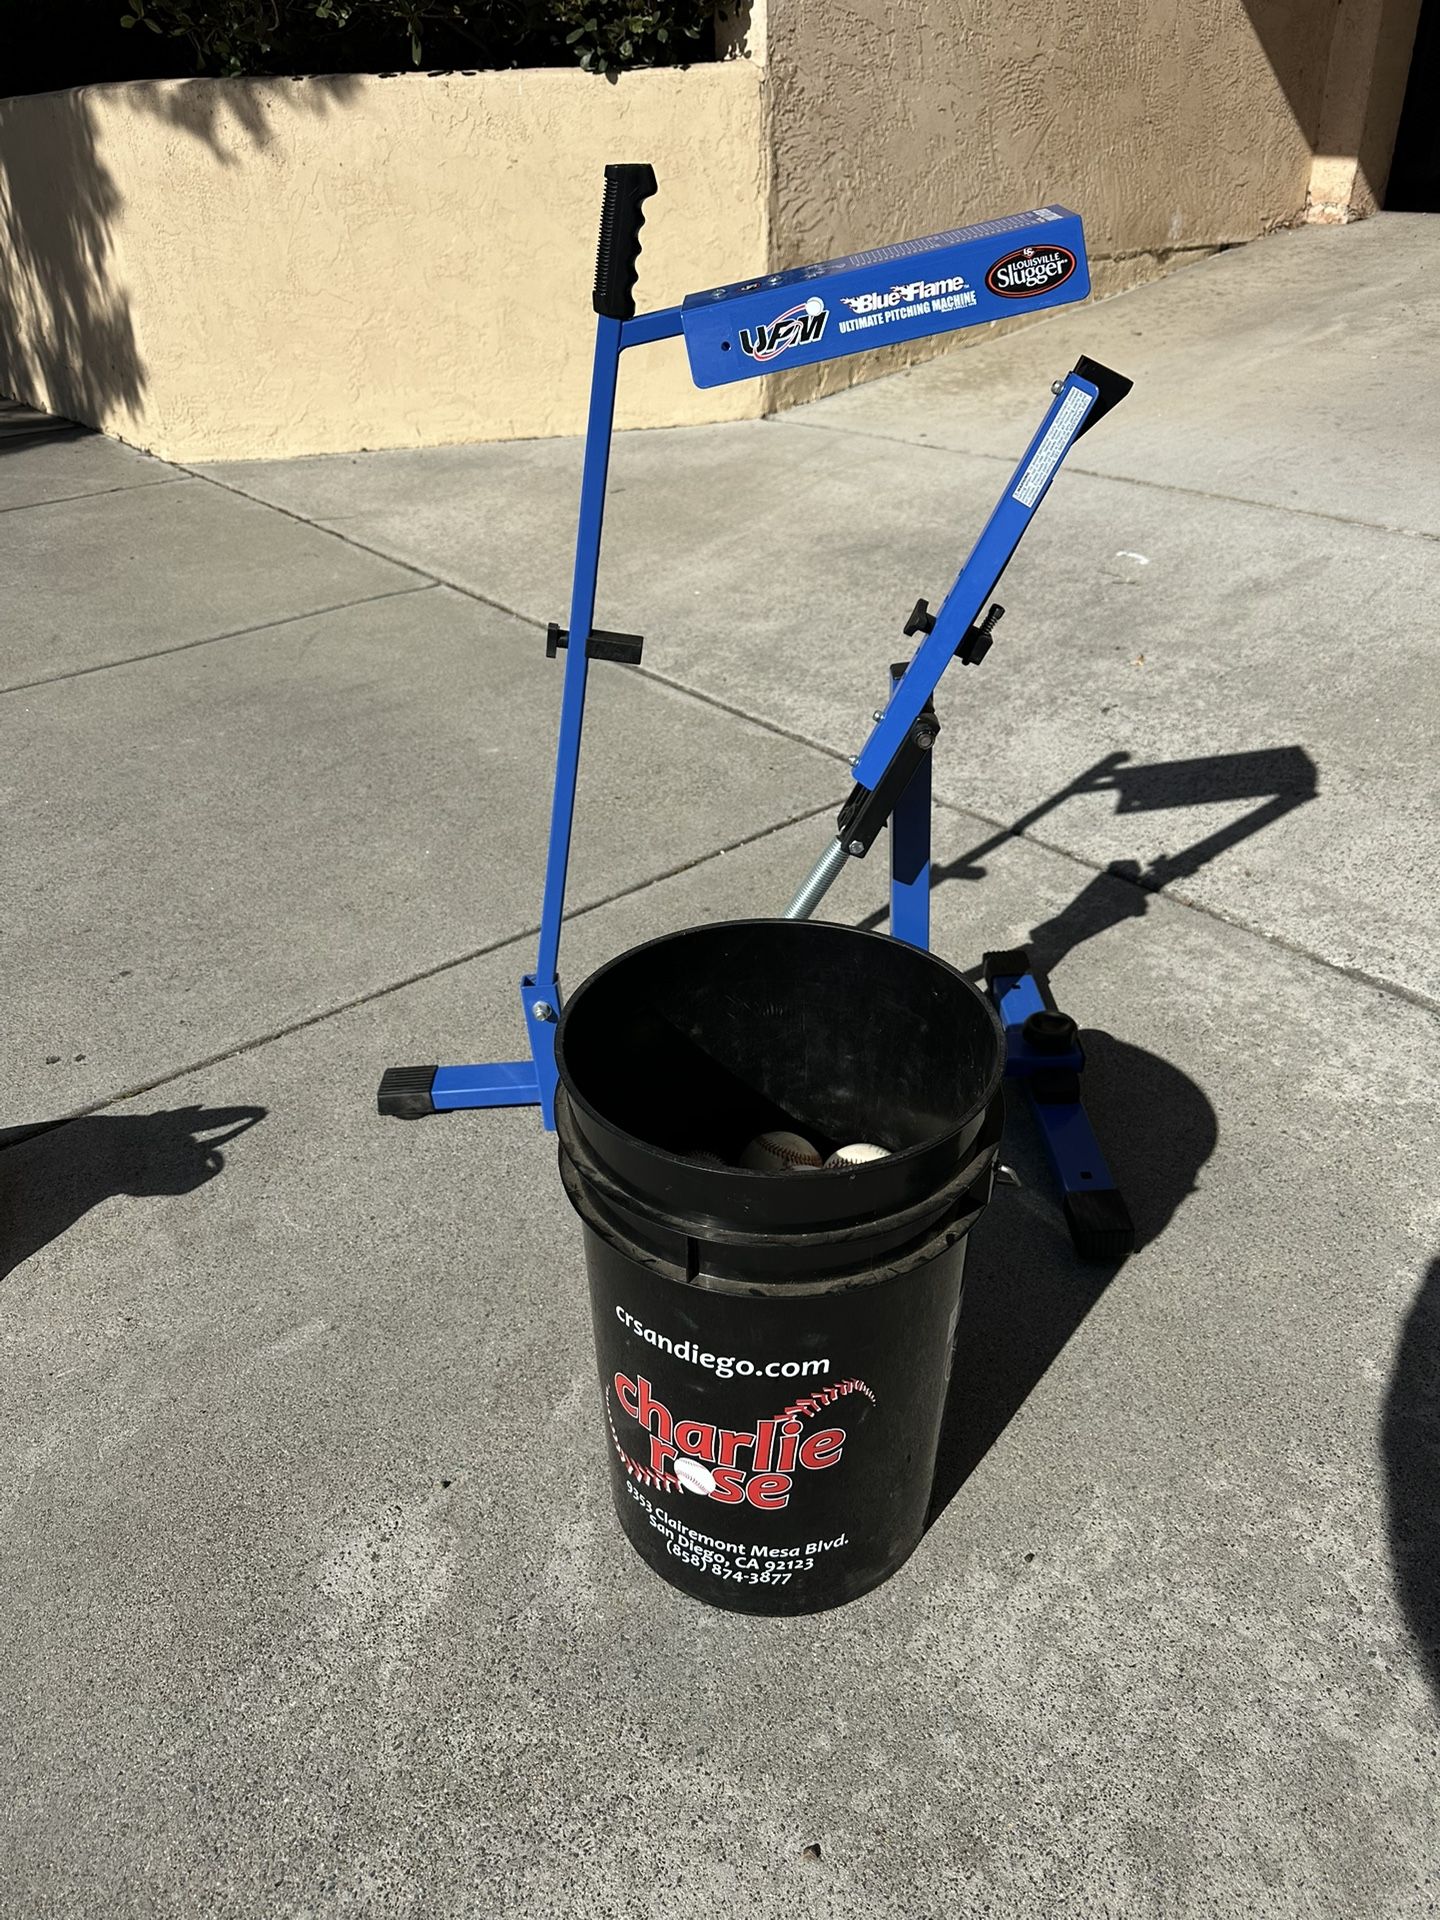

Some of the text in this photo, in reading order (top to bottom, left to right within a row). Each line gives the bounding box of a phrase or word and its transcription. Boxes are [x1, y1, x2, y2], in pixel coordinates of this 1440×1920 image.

[997, 259, 1064, 287] Slugger
[1012, 252, 1060, 270] LOUISVILLE
[839, 314, 884, 333] ULTIMATE
[885, 302, 931, 323] PITCHING
[931, 290, 977, 311] MACHINE
[851, 292, 901, 314] Blue
[739, 310, 829, 356] UPM
[615, 1305, 830, 1378] crsandiego.com
[614, 1371, 846, 1473] charlie
[626, 1480, 849, 1558] 9353 Clairemont Mesa Blvd.
[649, 1514, 814, 1573] San Diego, CA 92123
[666, 1540, 792, 1585] (858) 874-3877
